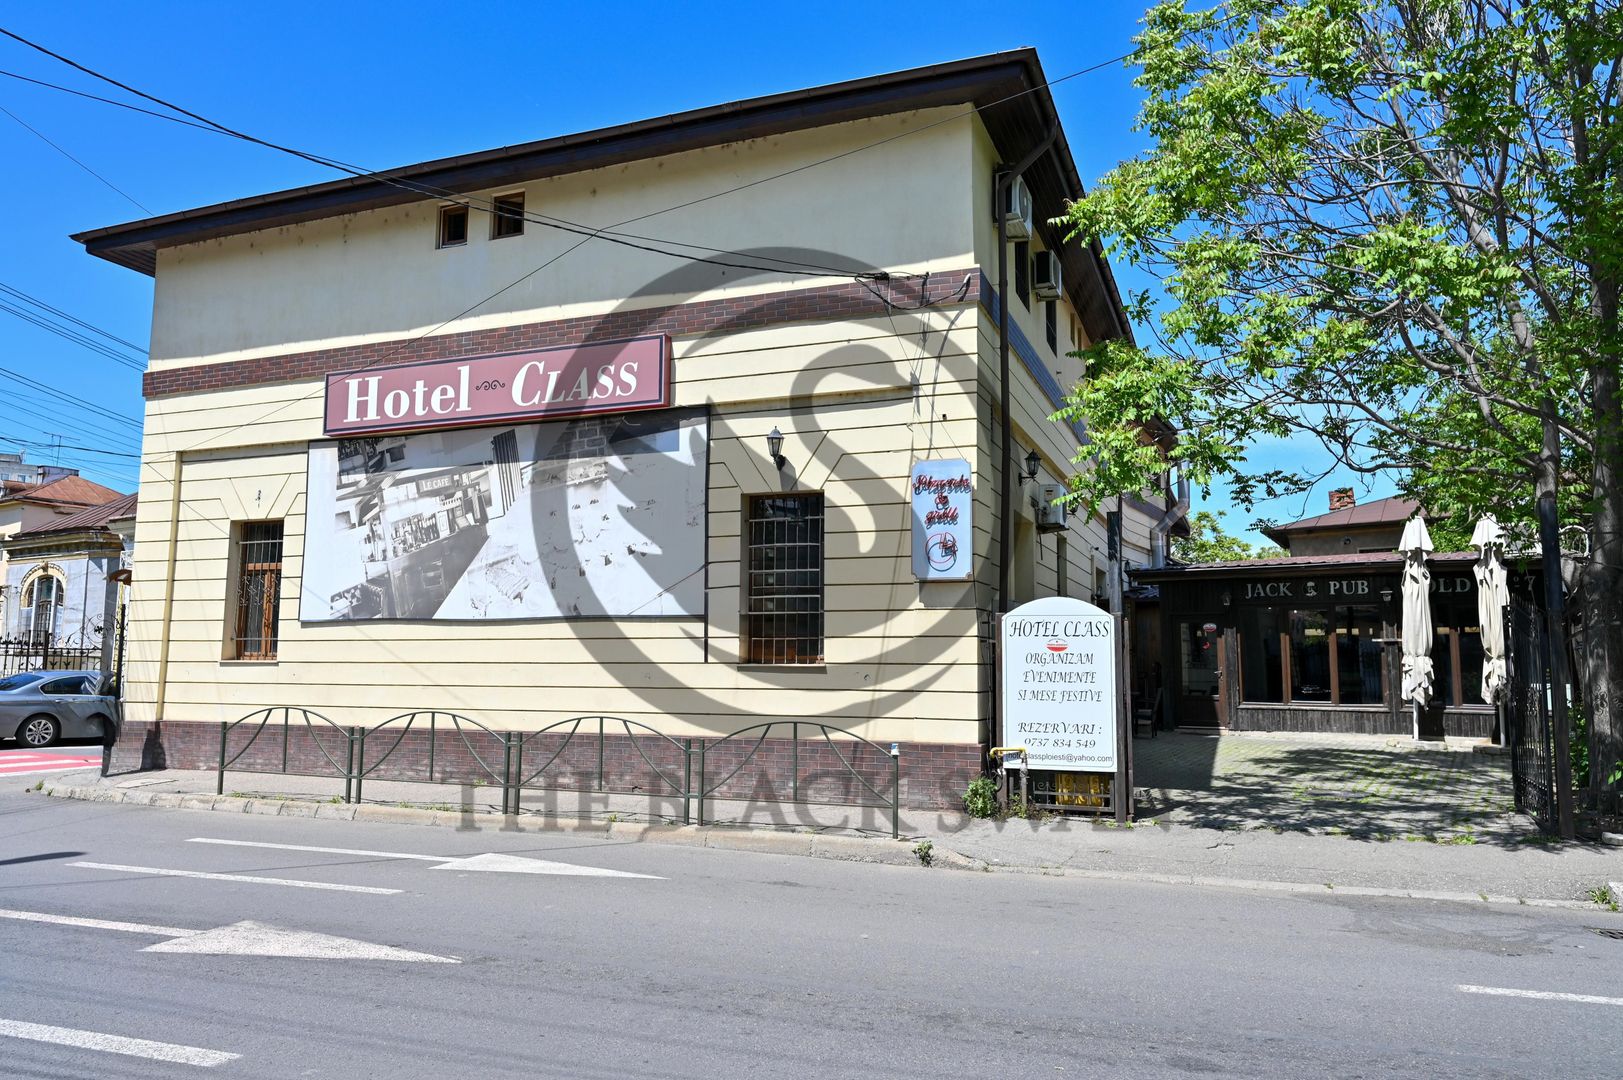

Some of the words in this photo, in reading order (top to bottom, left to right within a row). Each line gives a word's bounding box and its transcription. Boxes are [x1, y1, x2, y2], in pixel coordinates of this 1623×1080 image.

[343, 365, 472, 424] Hotel
[511, 360, 639, 407] CLASS
[1245, 582, 1293, 600] JACK
[1328, 580, 1370, 596] PUB
[1009, 618, 1060, 637] HOTEL
[1063, 620, 1110, 638] CLASS
[1025, 652, 1095, 667] ORGANIZAM
[1023, 669, 1097, 684] EVENIMENTE
[1018, 689, 1027, 701] SI
[1029, 689, 1057, 701] MESE
[1059, 688, 1103, 704] FESTIVE
[1017, 721, 1096, 735] REZERVARI
[1024, 737, 1050, 747] 0737
[1052, 738, 1072, 748] 834
[1075, 739, 1097, 749] 549
[1008, 751, 1114, 763] hotlassploiesti@yahoo.com
